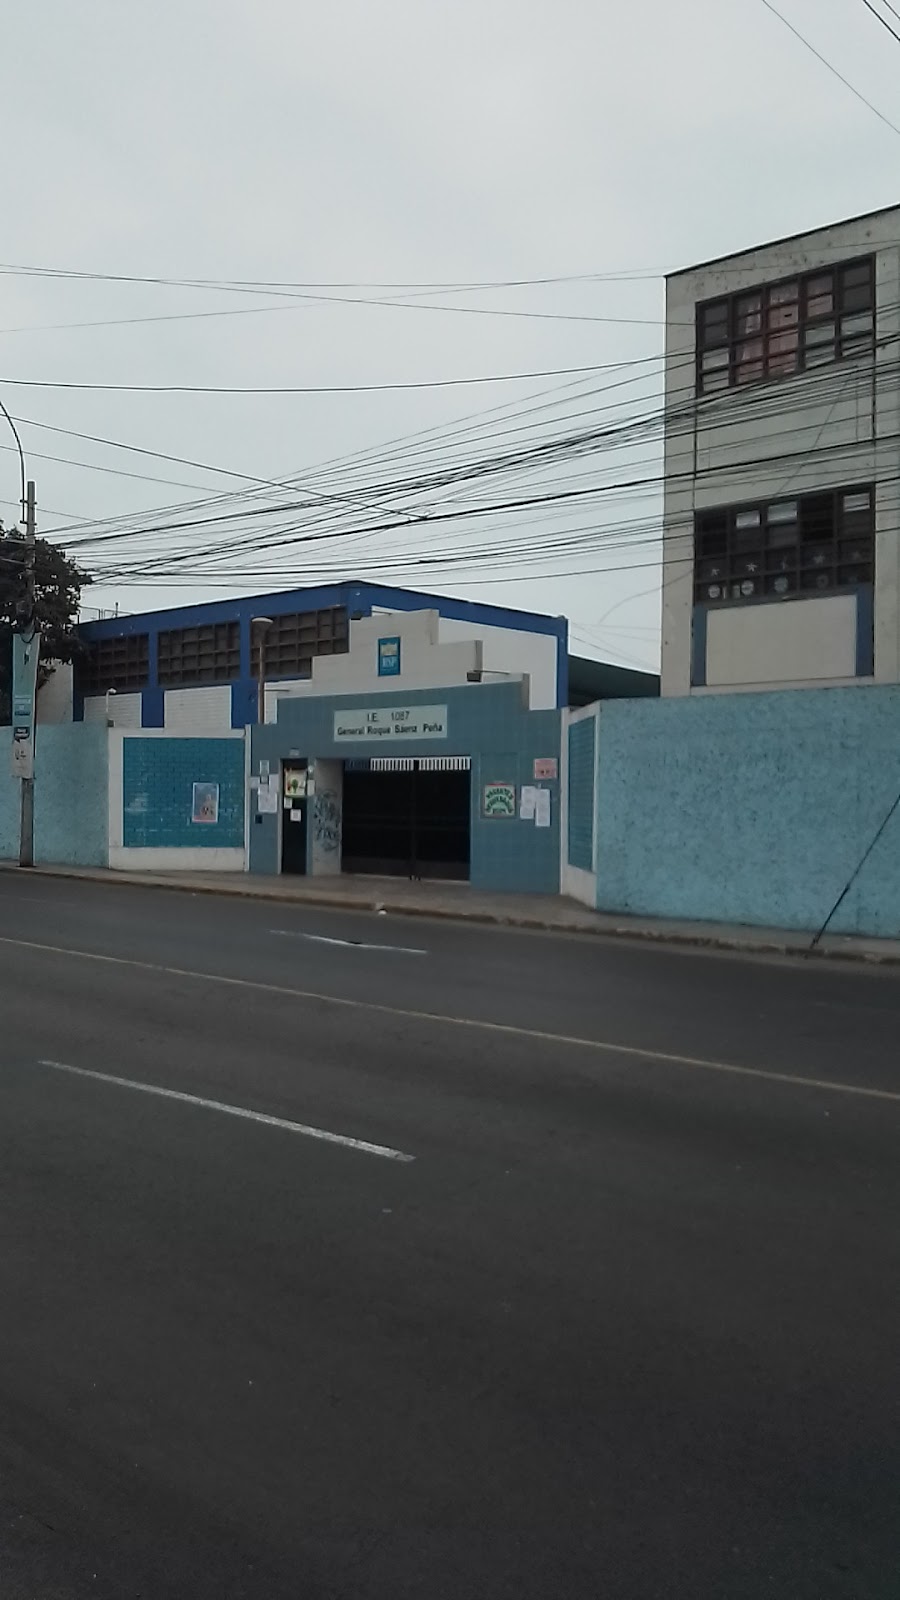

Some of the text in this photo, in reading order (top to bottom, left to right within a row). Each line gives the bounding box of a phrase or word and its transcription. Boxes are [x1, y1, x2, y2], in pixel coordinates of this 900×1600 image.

[337, 726, 365, 736] General
[367, 725, 391, 736] Roque
[423, 722, 443, 733] Peña
